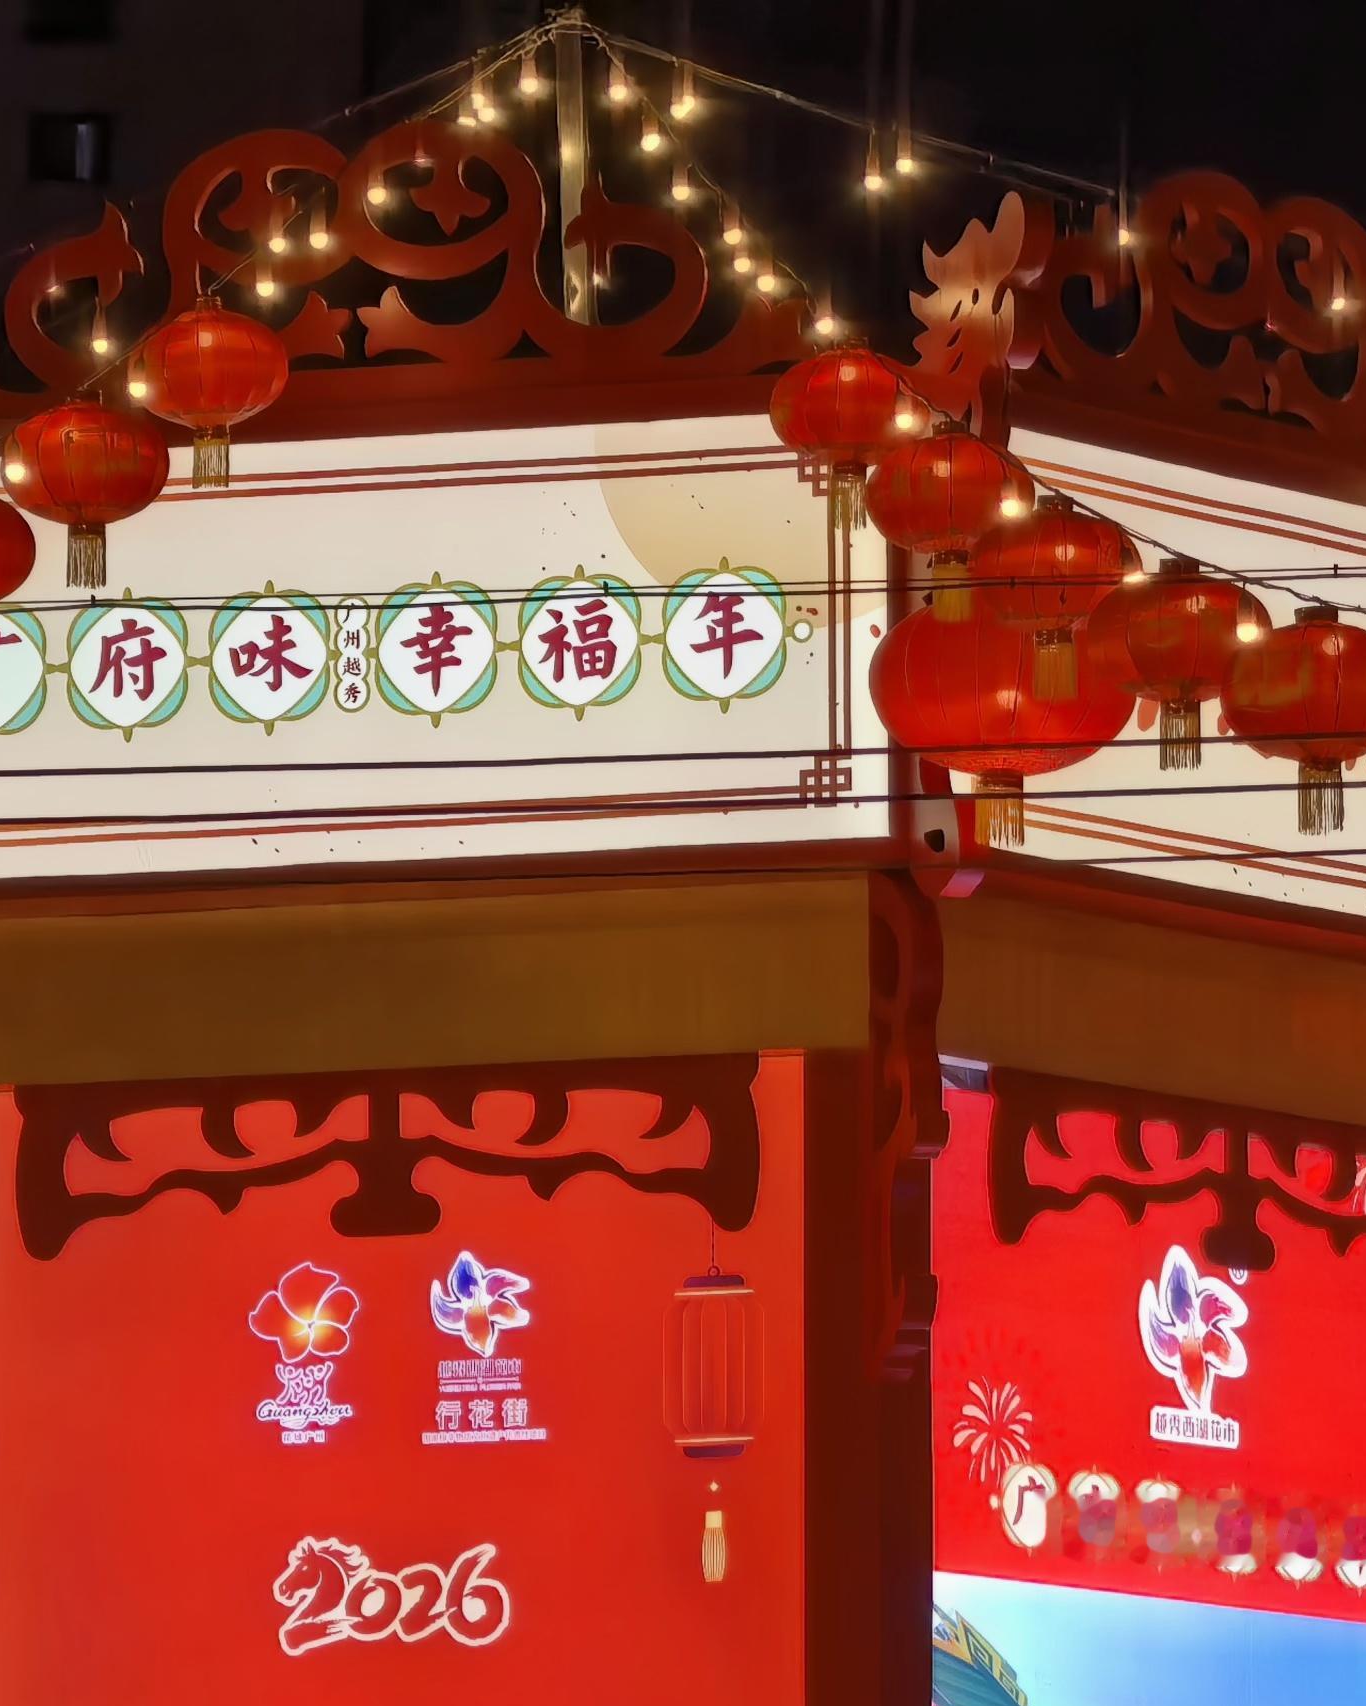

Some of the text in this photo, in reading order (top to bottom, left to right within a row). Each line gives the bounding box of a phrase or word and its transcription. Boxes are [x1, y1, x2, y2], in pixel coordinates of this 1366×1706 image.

[342, 602, 362, 704] 广州越秀
[435, 1398, 528, 1430] 行花街
[273, 1537, 510, 1656] 2026
